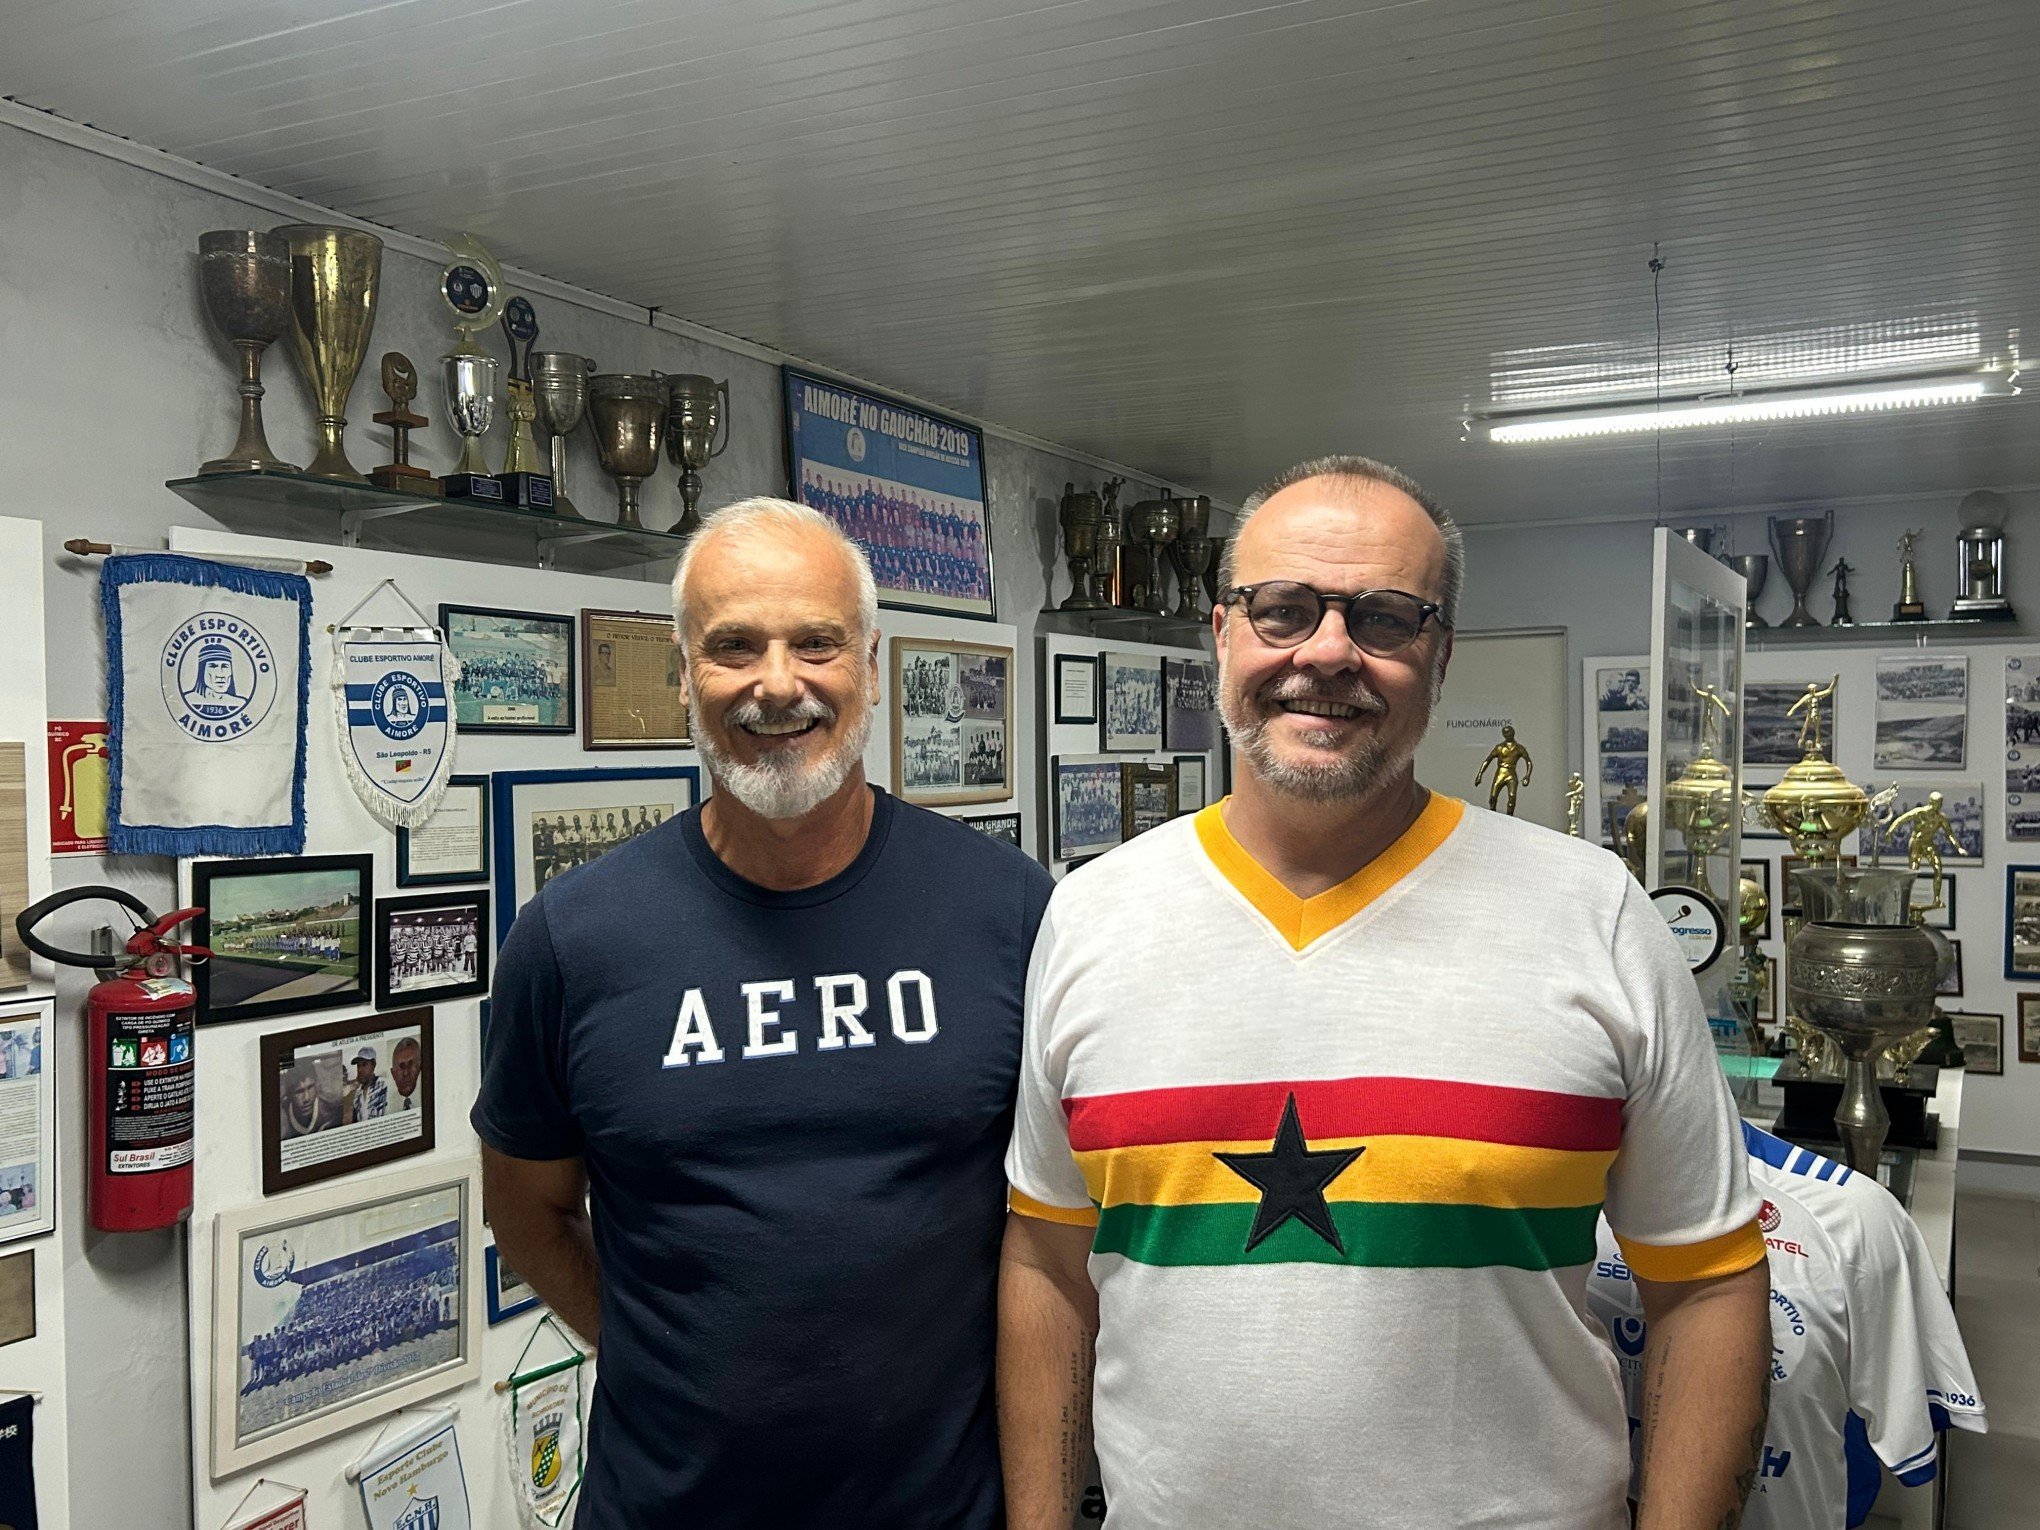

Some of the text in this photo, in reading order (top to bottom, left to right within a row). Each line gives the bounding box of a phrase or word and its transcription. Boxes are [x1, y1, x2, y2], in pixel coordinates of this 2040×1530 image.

[804, 385, 969, 456] AIMORÉ NO GAUCHÃO 2019
[166, 618, 270, 673] CLUBE ESPORTIVO
[350, 655, 373, 663] CLUBE
[413, 654, 435, 662] AIMORÉ
[375, 674, 427, 710] CLUBE ESPORTIVO
[206, 707, 223, 715] 1936
[179, 713, 252, 737] AIMORÉ
[1446, 716, 1512, 728] FUNCIONÁRIOS
[384, 725, 419, 738] AIMORÉ
[389, 750, 419, 758] Leopoldo
[986, 818, 1017, 830] GRANDE
[1671, 927, 1712, 935] ogresso
[661, 967, 940, 1069] AERO
[143, 1078, 153, 1086] USE
[143, 1093, 162, 1102] APERTE
[143, 1101, 160, 1110] DIRIJA
[114, 1152, 155, 1162] Sul Brasil
[1766, 1237, 1809, 1258] ATEL
[255, 1245, 268, 1271] CLUBE
[1770, 1289, 1805, 1336] ORTIVO
[559, 1384, 569, 1393] DE
[1946, 1392, 1975, 1406] 1936
[377, 1441, 443, 1485] Esporte Clube
[373, 1451, 449, 1501] Novo Hamburgo
